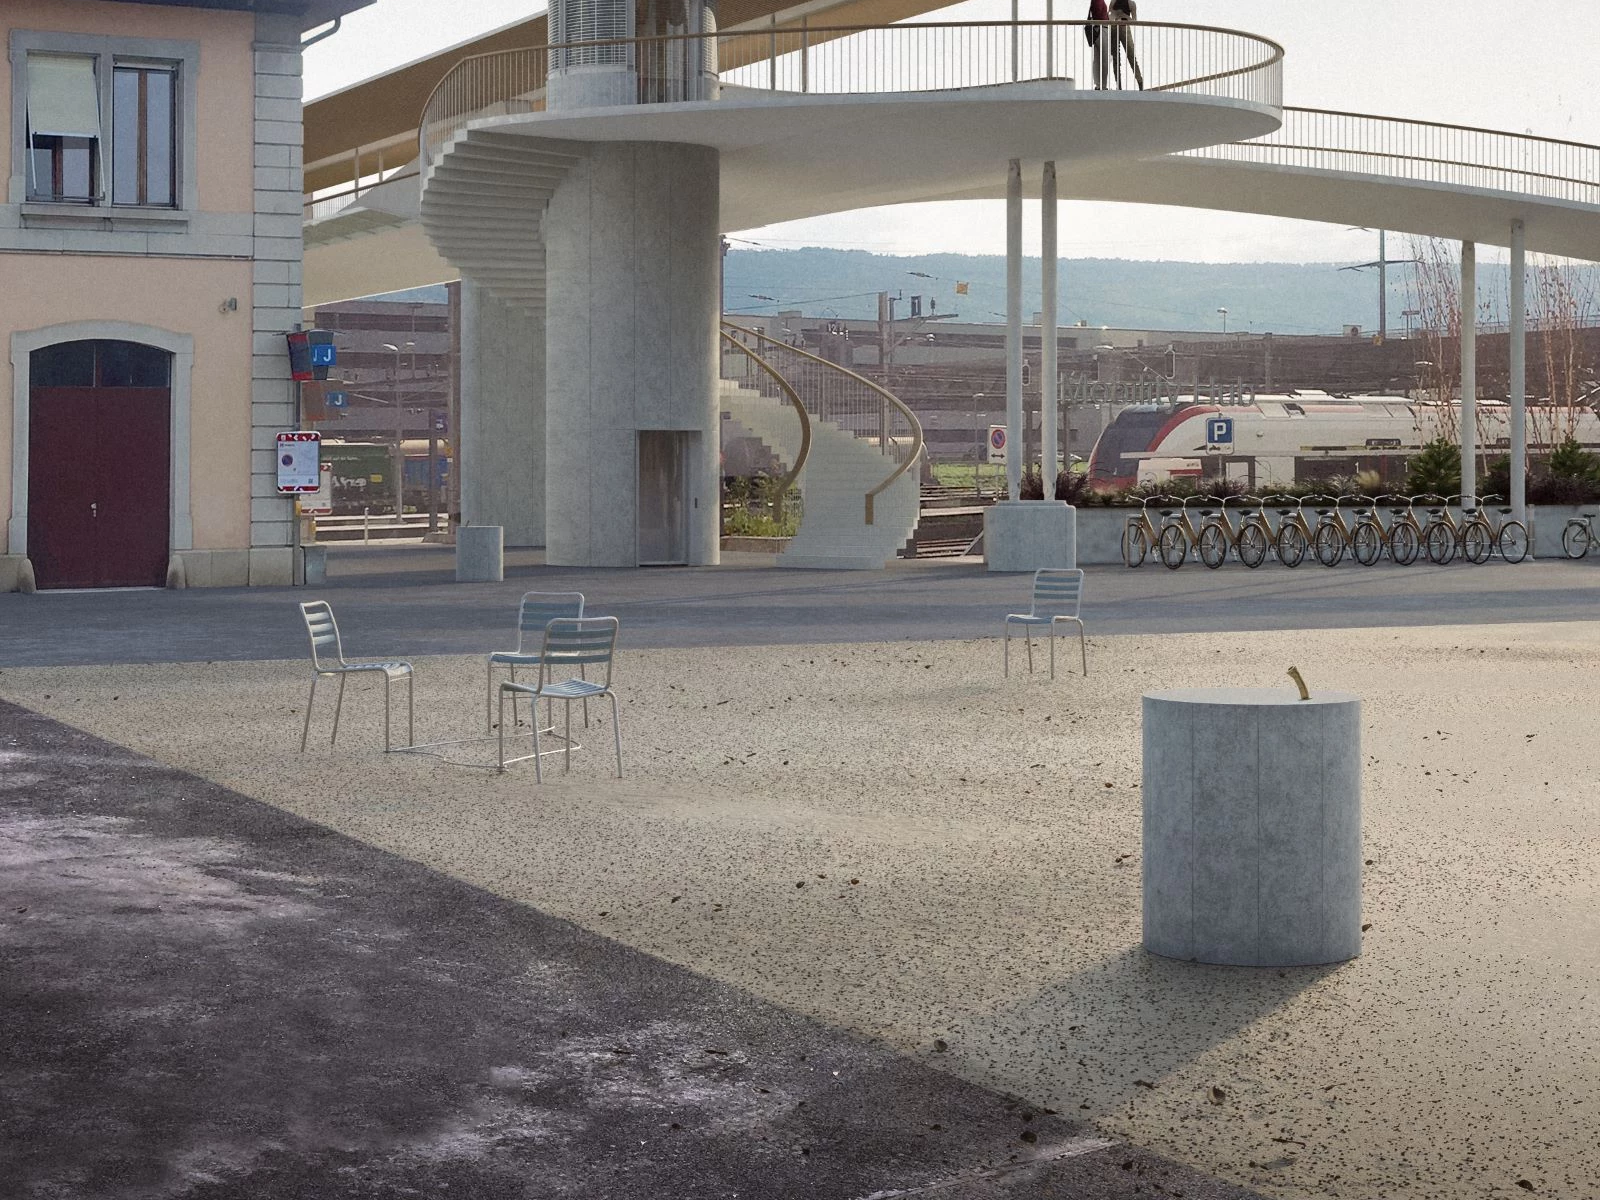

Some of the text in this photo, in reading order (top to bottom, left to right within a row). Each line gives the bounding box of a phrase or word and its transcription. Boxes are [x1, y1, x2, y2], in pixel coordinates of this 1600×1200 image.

[323, 348, 331, 362] J
[1060, 371, 1256, 413] Mobility Hub
[1213, 422, 1226, 441] P
[1354, 461, 1359, 474] 1
